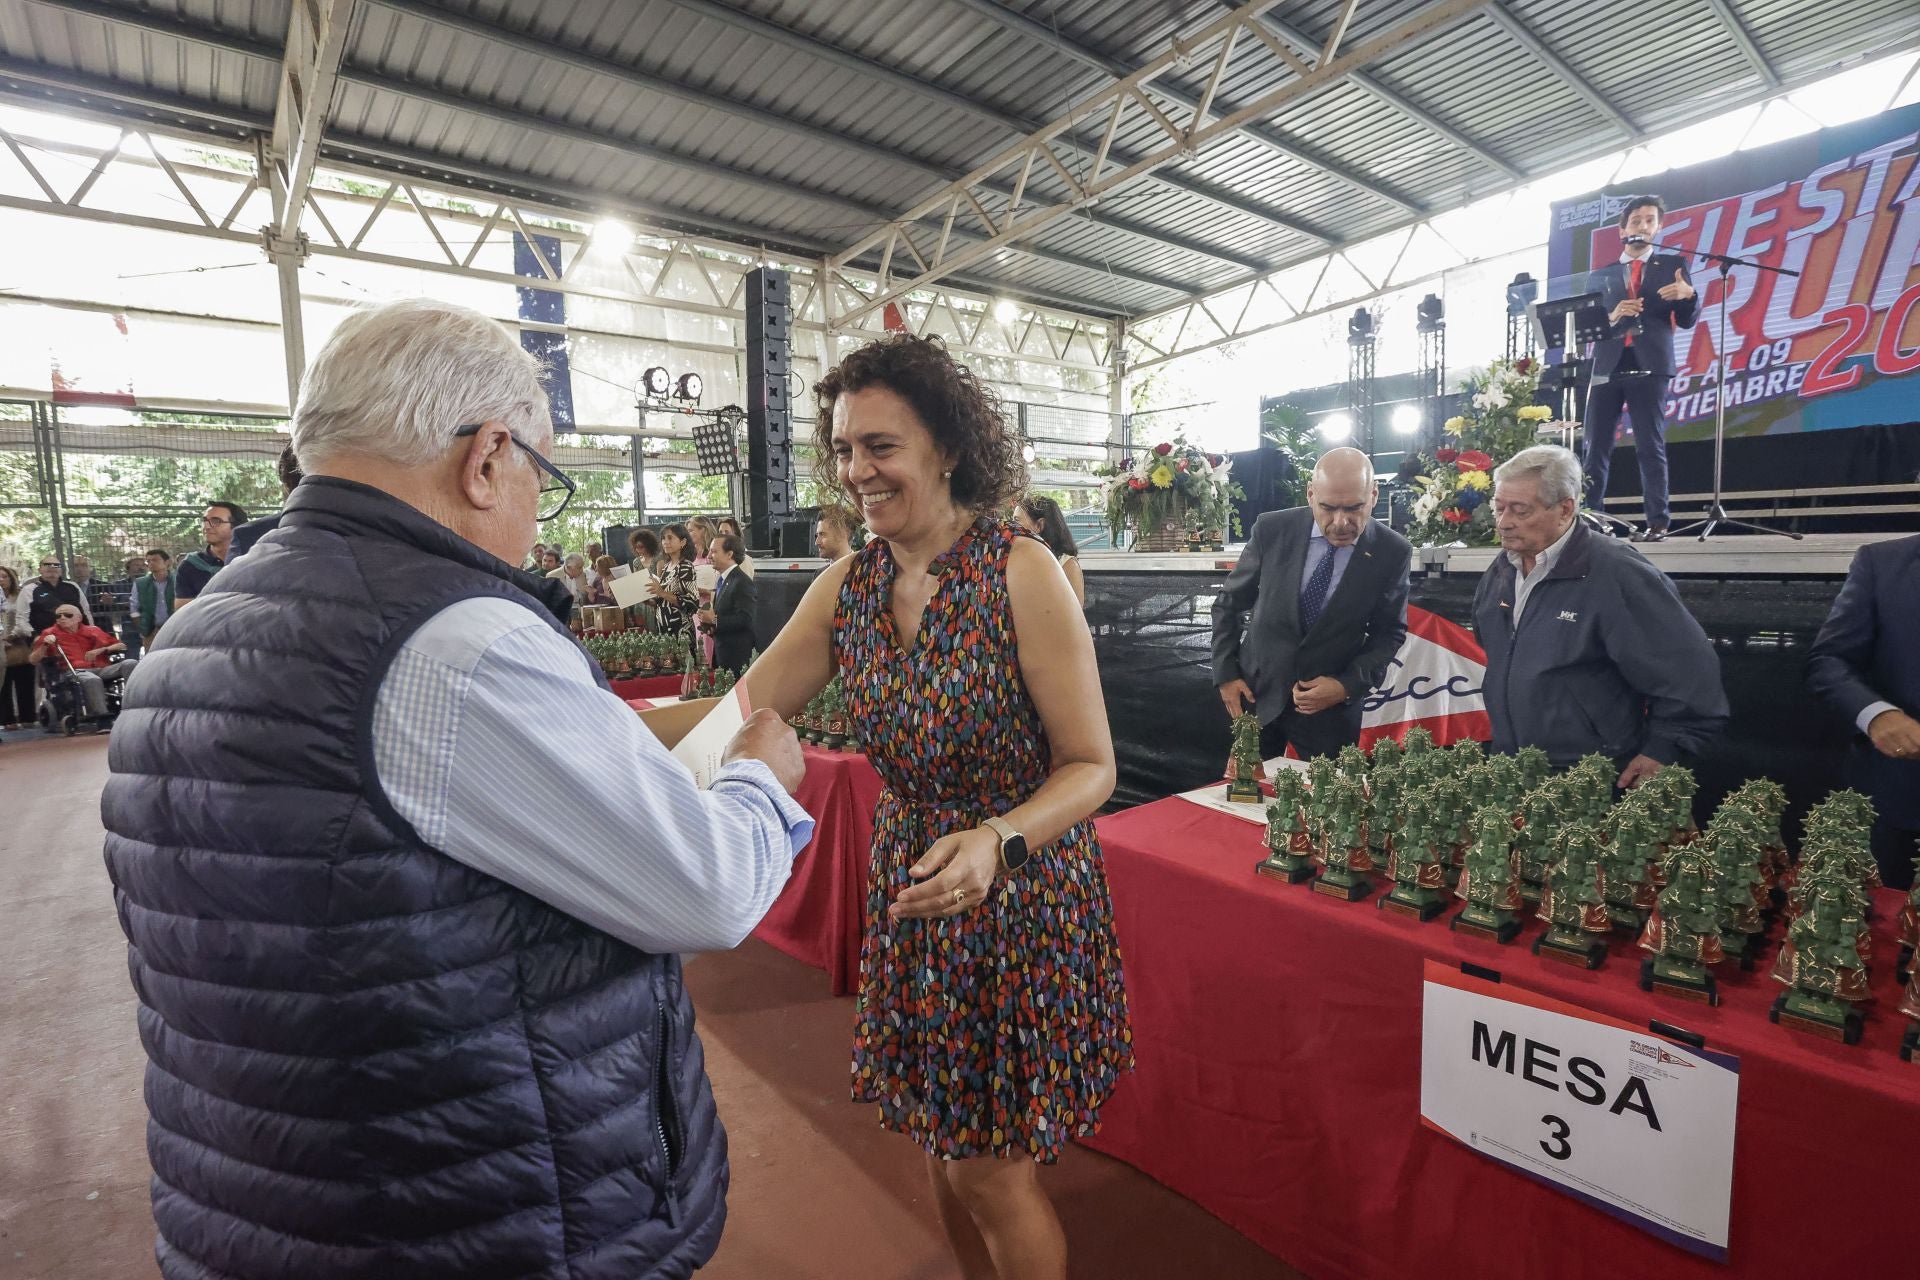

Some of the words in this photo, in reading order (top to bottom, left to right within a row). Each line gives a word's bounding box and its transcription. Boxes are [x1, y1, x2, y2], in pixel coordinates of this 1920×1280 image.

[1668, 367, 1692, 393] 6
[1701, 354, 1737, 386] AL
[1749, 338, 1792, 370] 09
[1471, 1020, 1662, 1133] MESA
[1539, 1114, 1572, 1161] 3
